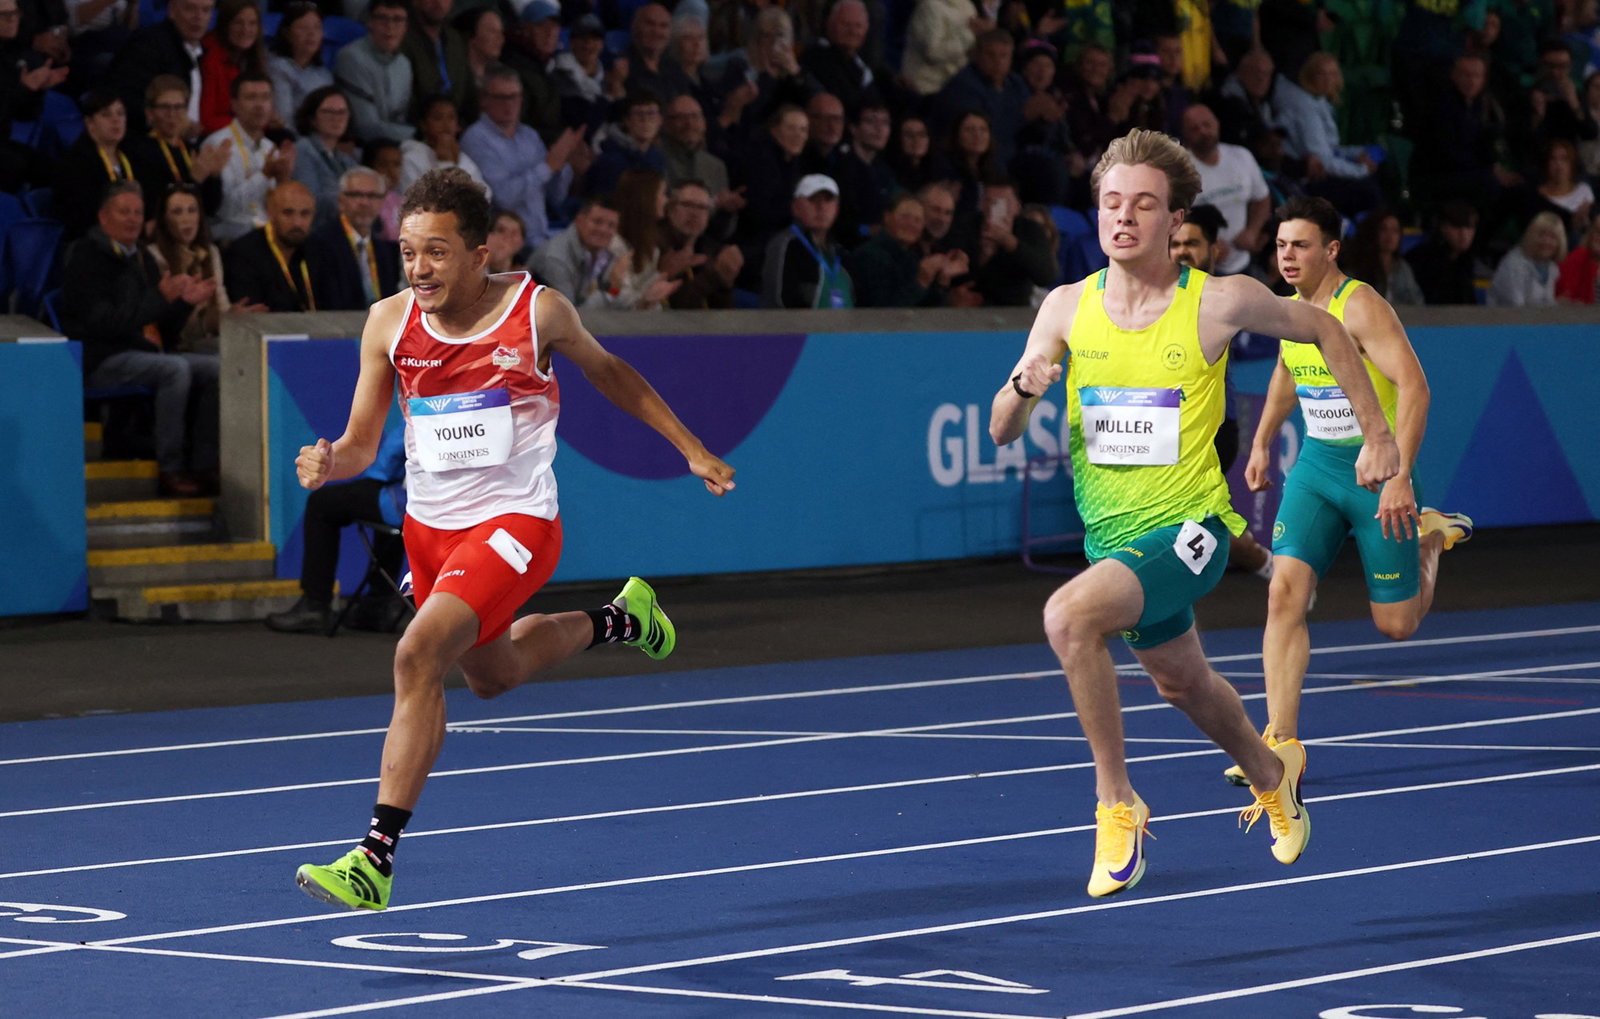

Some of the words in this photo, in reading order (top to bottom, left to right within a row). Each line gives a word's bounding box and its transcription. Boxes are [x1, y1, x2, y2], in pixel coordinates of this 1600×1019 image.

[407, 357, 442, 368] KUKRI
[434, 423, 486, 441] YOUNG
[1095, 420, 1154, 434] MULLER
[928, 400, 1073, 487] GLAS
[1099, 444, 1150, 455] LONGINES
[438, 448, 490, 462] LONGINES
[1187, 533, 1205, 561] 4
